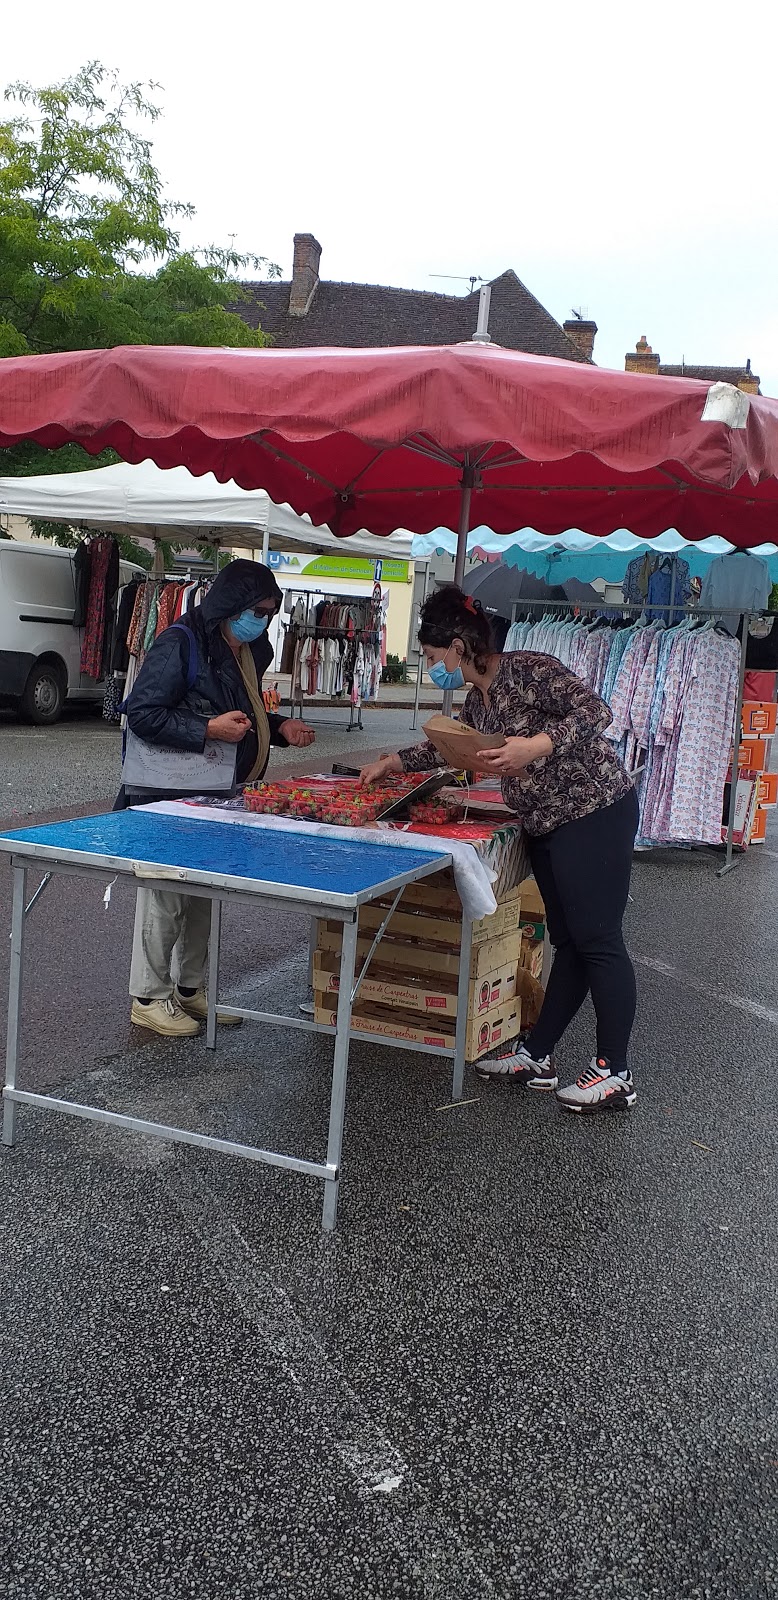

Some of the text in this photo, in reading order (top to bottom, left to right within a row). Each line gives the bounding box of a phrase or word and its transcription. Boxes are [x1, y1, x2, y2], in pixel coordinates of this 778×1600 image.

[269, 554, 300, 566] UNA
[376, 984, 384, 993] de
[384, 985, 419, 1000] Carpentras
[376, 1024, 384, 1033] de
[383, 1025, 419, 1041] Carpentras
